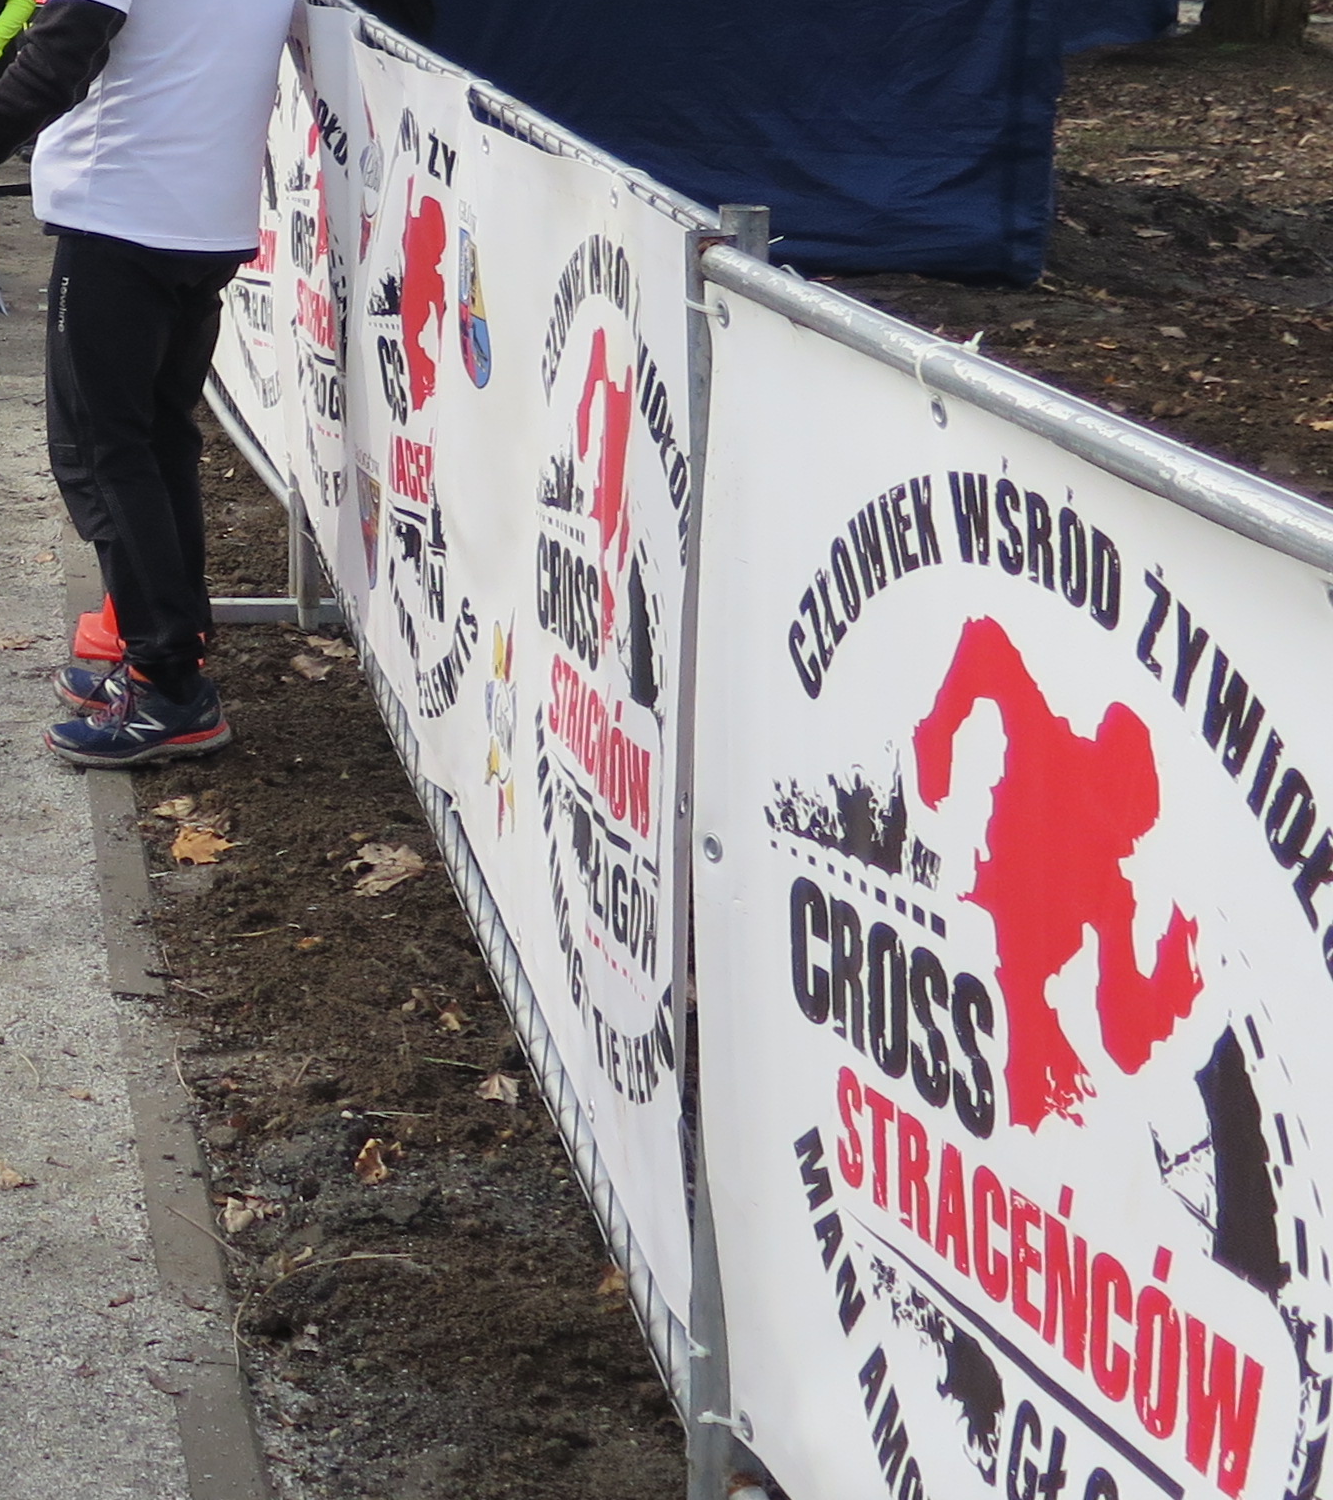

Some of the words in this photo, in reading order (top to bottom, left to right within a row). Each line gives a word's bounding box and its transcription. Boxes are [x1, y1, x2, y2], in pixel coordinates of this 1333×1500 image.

[536, 530, 600, 672] CROSS
[788, 474, 942, 699] CZŁOWIEK
[947, 455, 1122, 632] WŚRÓD
[1137, 562, 1333, 983] ŻYWIOŁ
[790, 877, 995, 1138] CROSS
[794, 1126, 867, 1337] MAN
[836, 1066, 1265, 1499] STRACEŃCÓW
